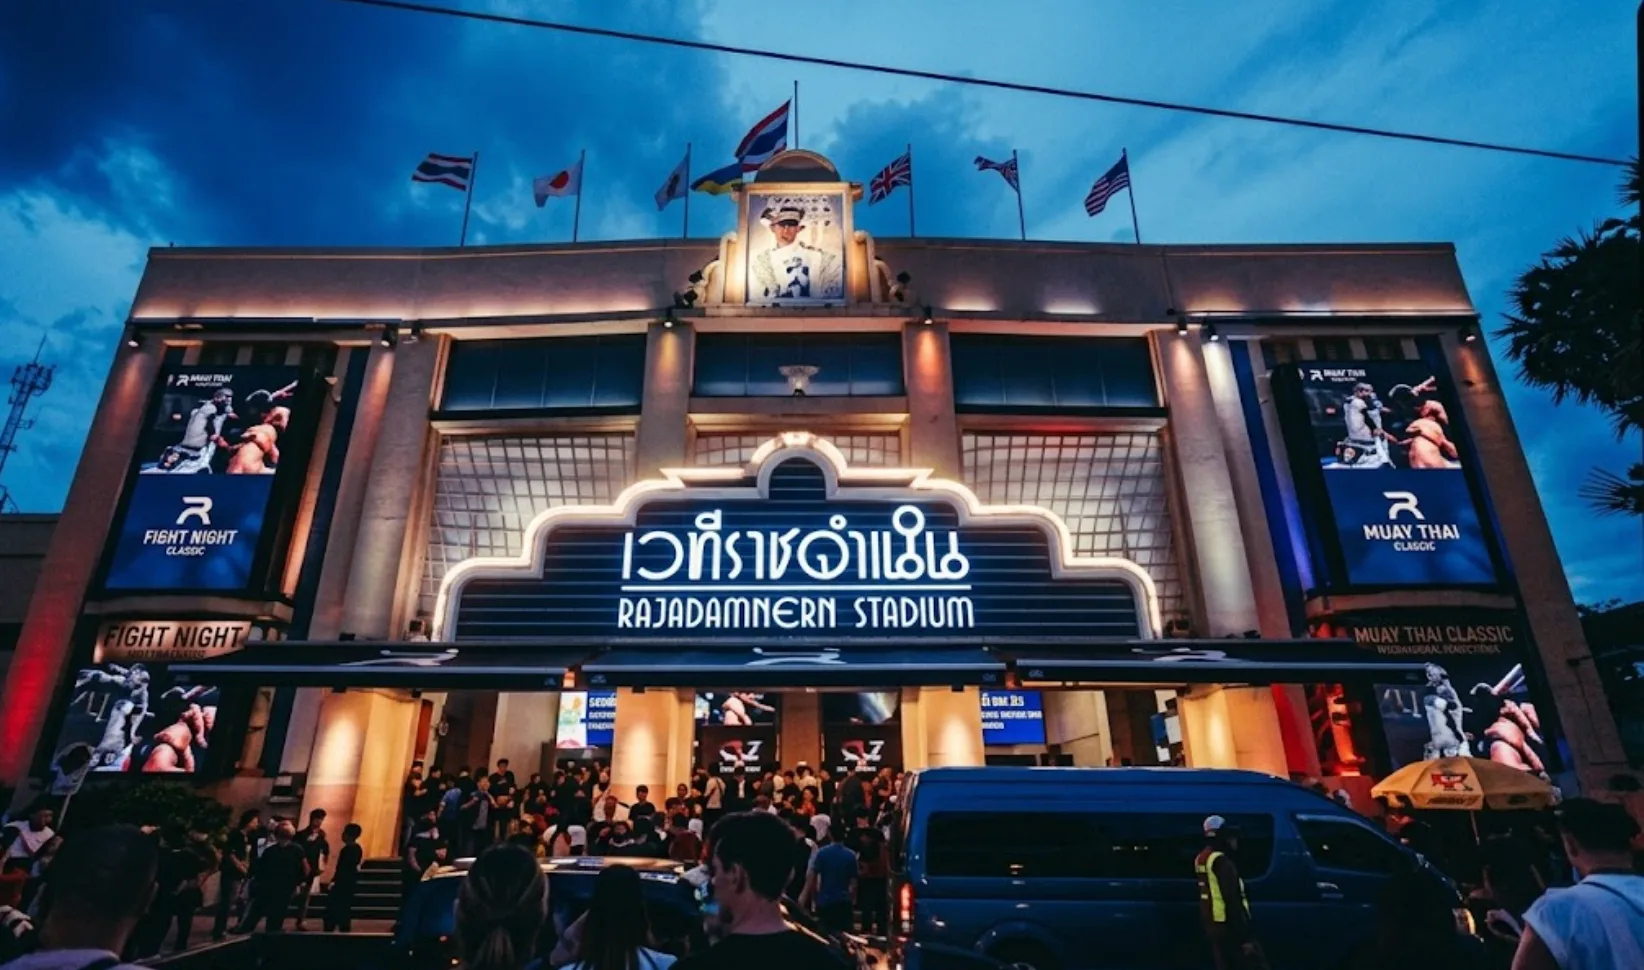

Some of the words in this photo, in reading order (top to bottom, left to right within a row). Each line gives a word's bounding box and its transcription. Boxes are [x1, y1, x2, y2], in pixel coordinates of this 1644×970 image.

[143, 530, 189, 544] FIGHT
[190, 530, 238, 544] NIGHT
[1363, 524, 1413, 541] MUAY
[1416, 524, 1460, 540] THAI
[621, 504, 970, 580] เวทีราชดำเนิน
[1393, 541, 1436, 552] CLASSIC
[165, 546, 205, 556] CLASSIC
[618, 596, 836, 628] RAJADAMNERN
[854, 596, 974, 628] STADIUM
[104, 626, 170, 647] FIGHT
[172, 626, 243, 648] NIGHT
[1354, 627, 1399, 643] MUAY
[1403, 626, 1443, 643] THAI
[1446, 625, 1514, 642] CLASSIC
